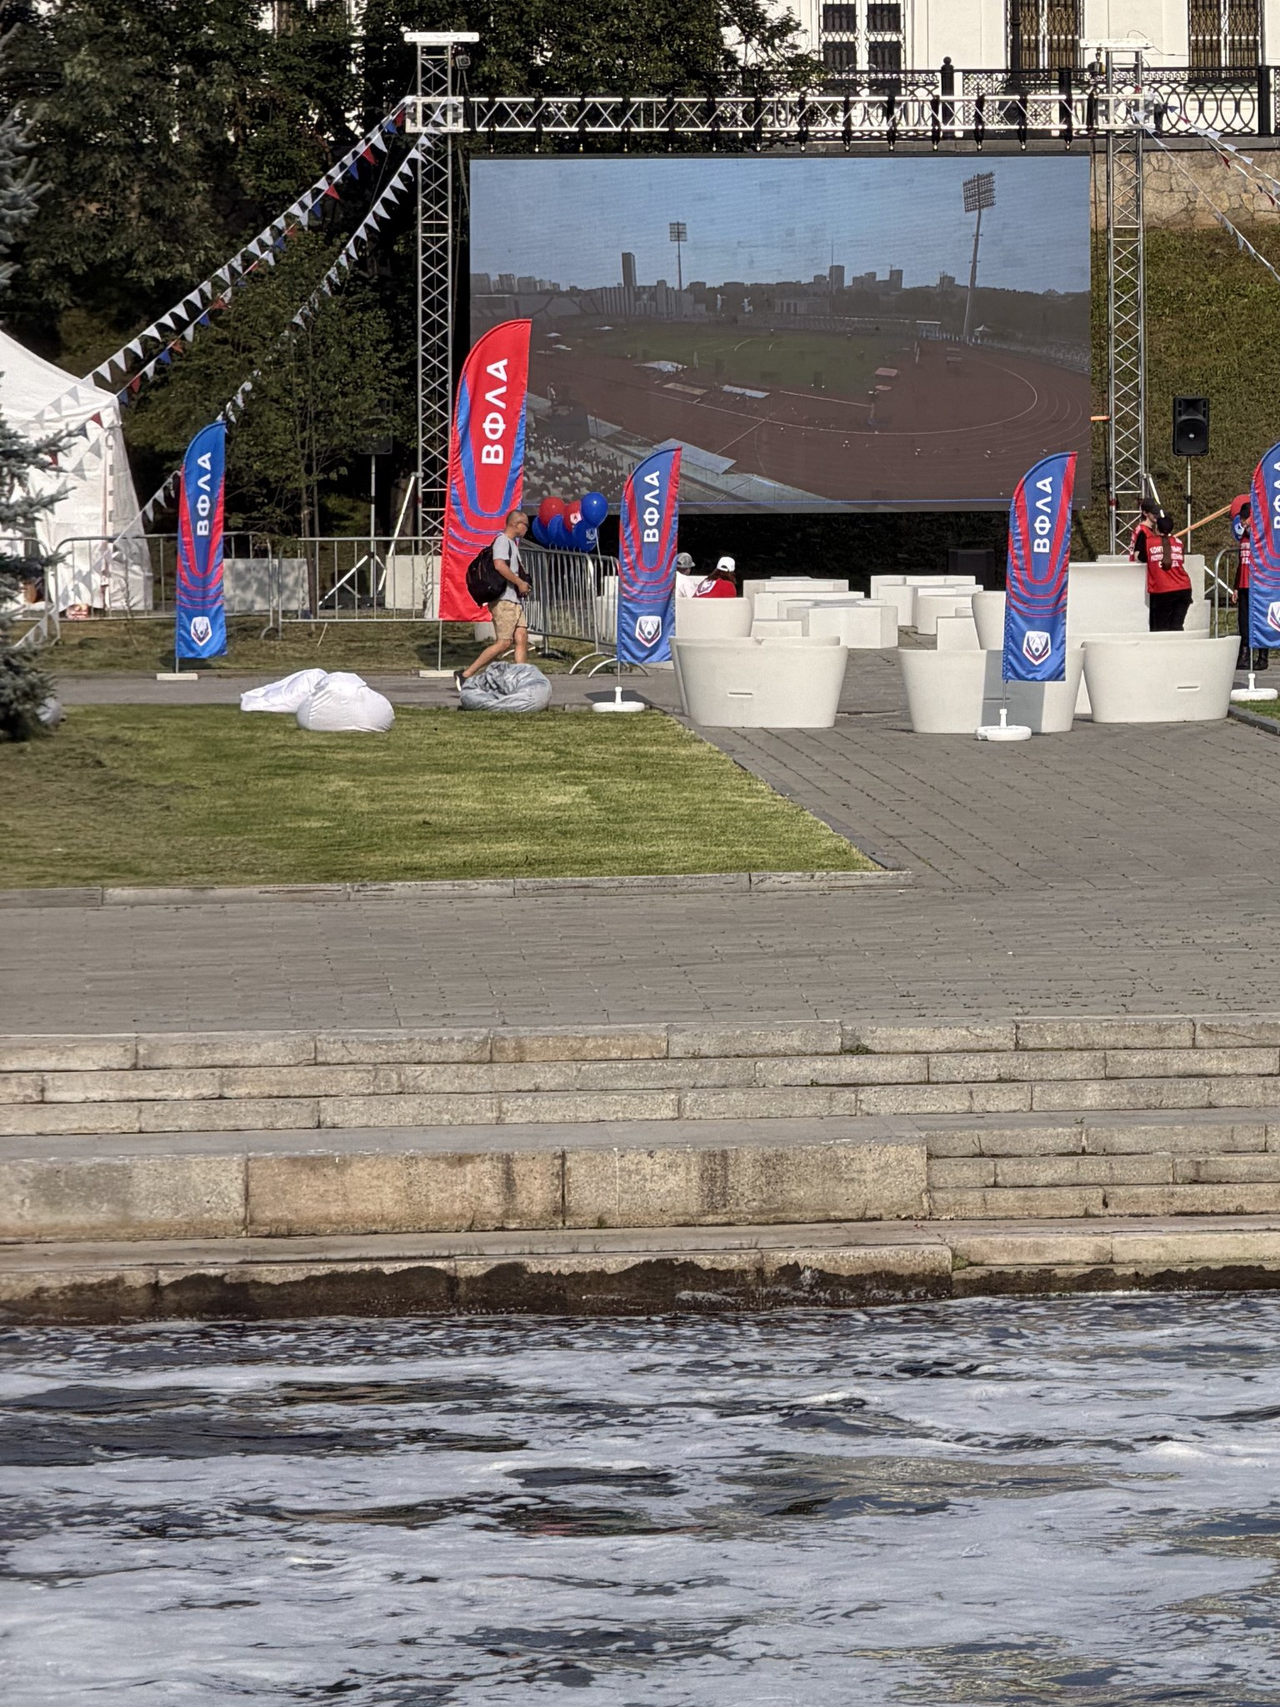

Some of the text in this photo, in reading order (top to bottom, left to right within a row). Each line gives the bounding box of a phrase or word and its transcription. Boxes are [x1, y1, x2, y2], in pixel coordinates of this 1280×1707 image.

[481, 358, 508, 465] ВФЛА
[196, 452, 212, 536] ВФЛА
[643, 470, 661, 544] ВФЛА
[1033, 476, 1053, 554] ВФЛА
